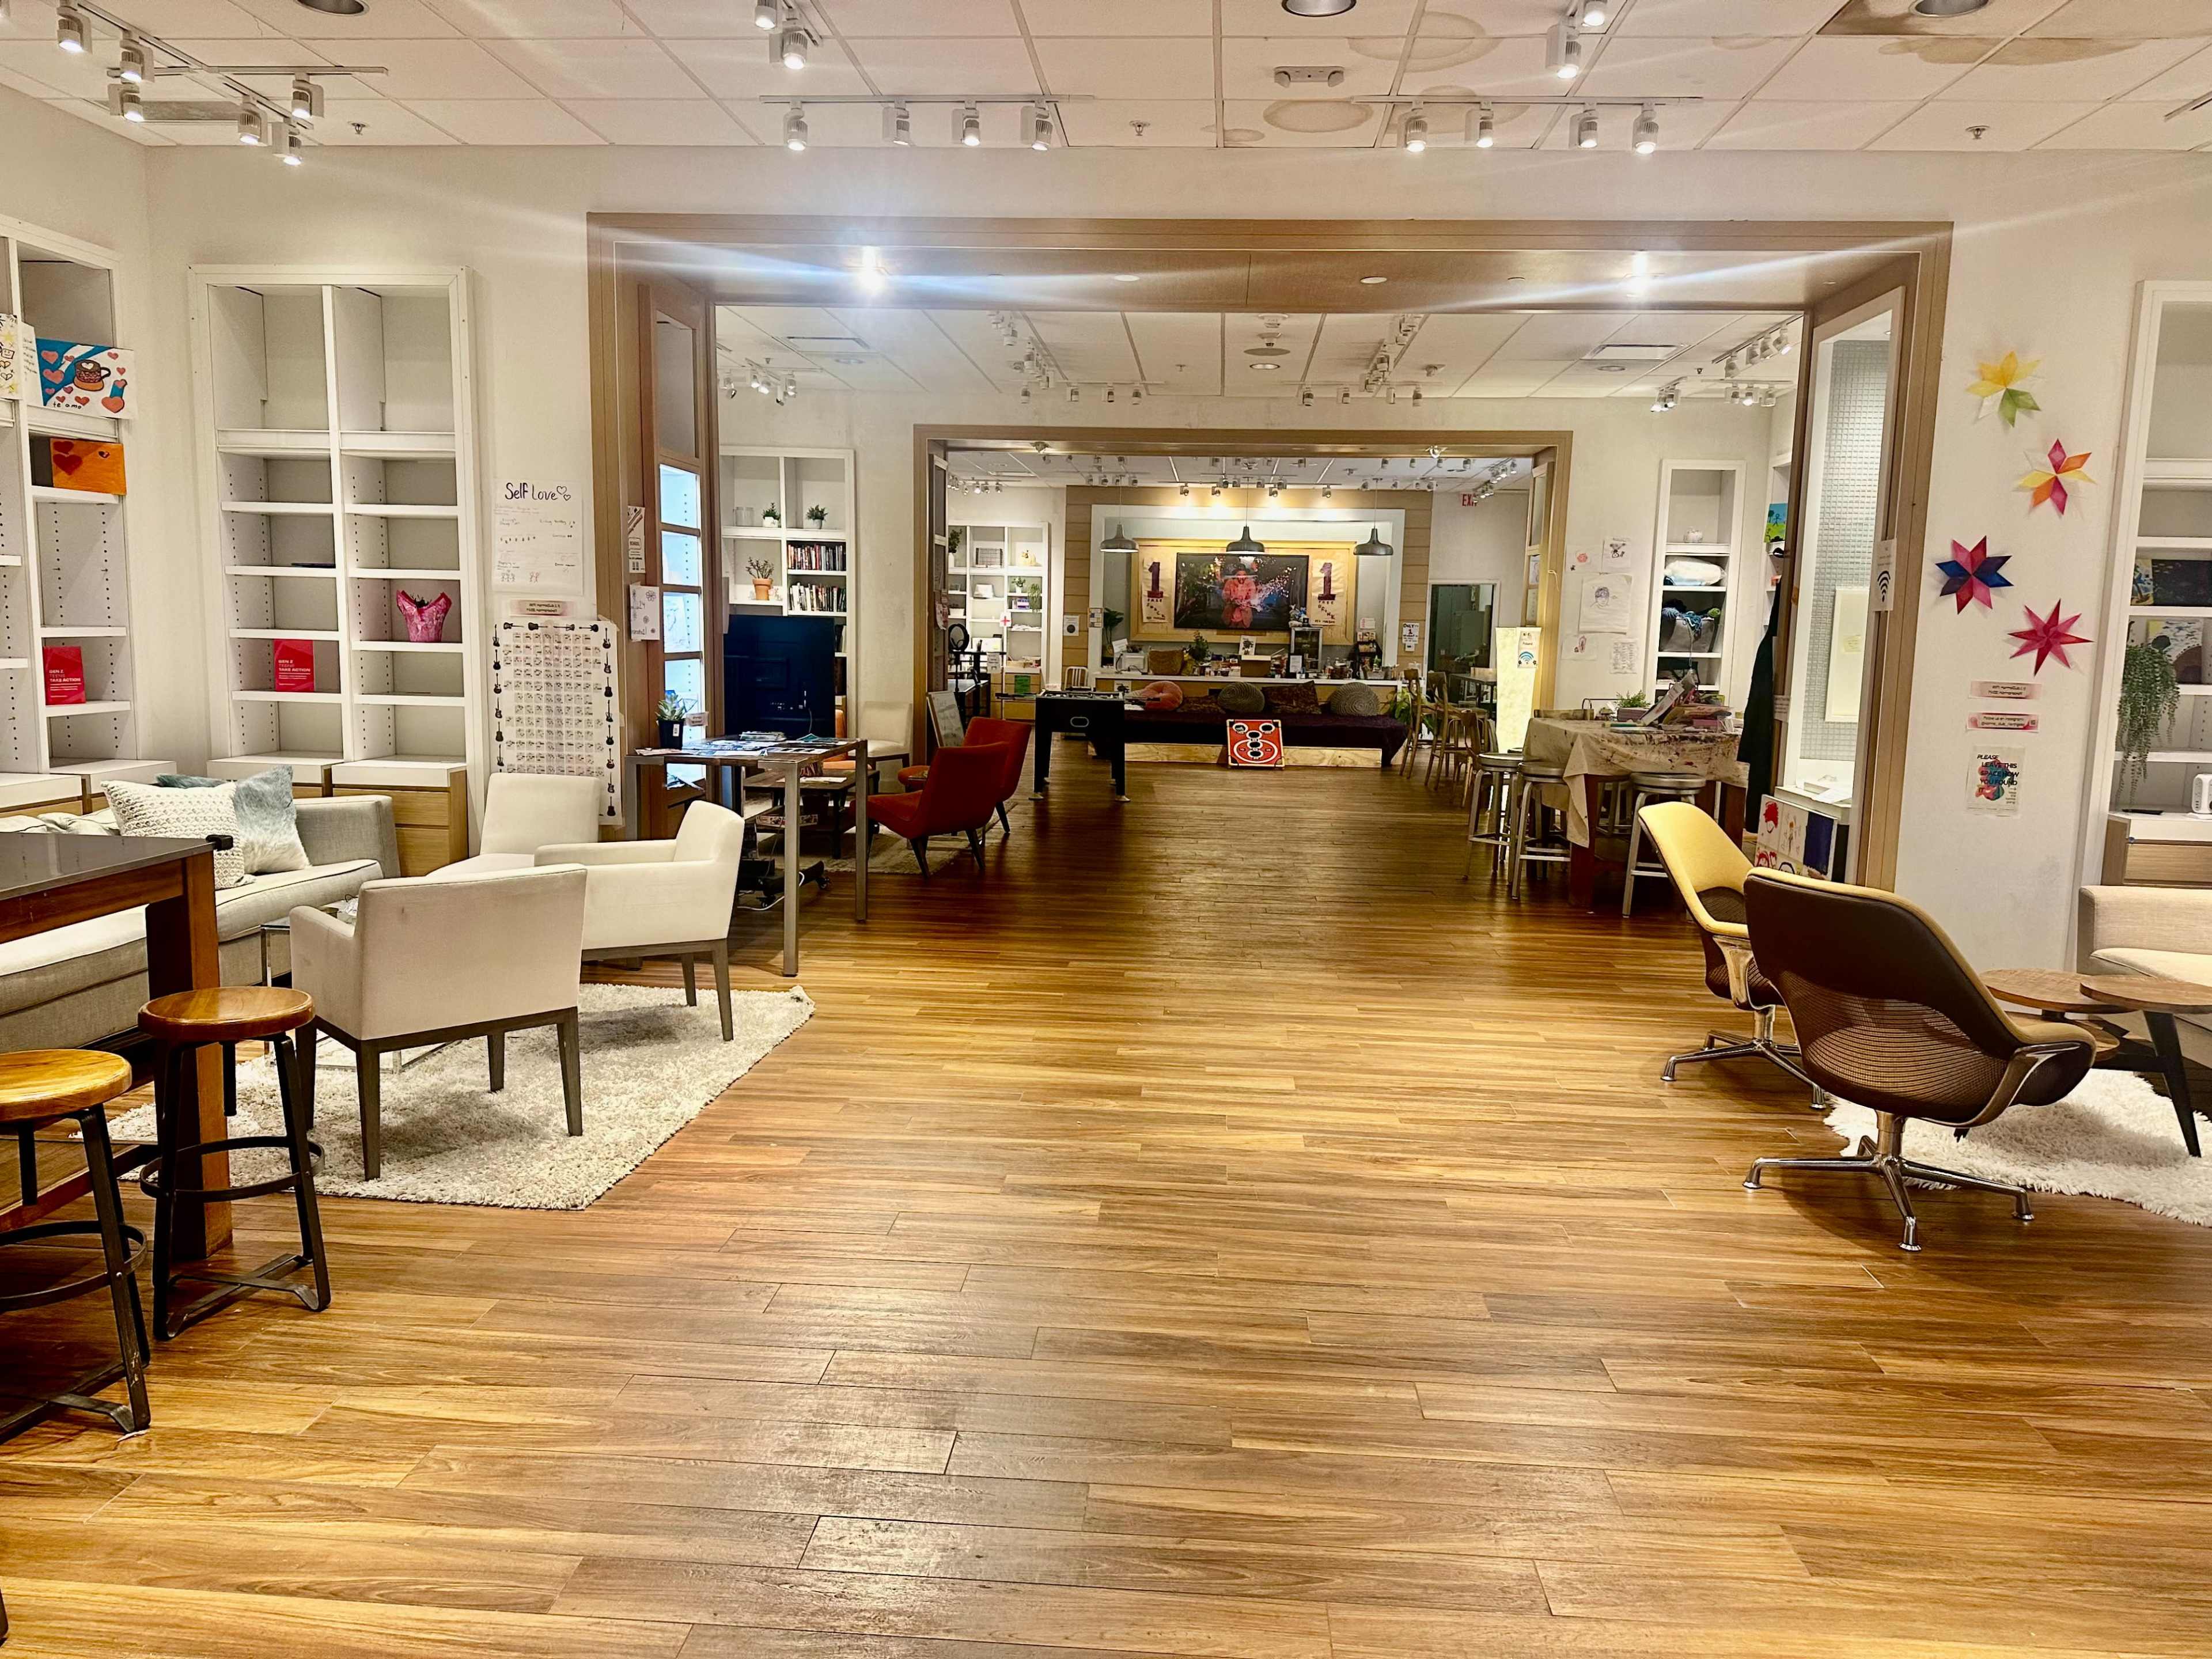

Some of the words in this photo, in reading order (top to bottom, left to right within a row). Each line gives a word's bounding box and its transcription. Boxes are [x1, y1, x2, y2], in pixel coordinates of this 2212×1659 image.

[505, 482, 529, 500] Self
[1148, 562, 1164, 599] 1
[1318, 562, 1336, 601] 1
